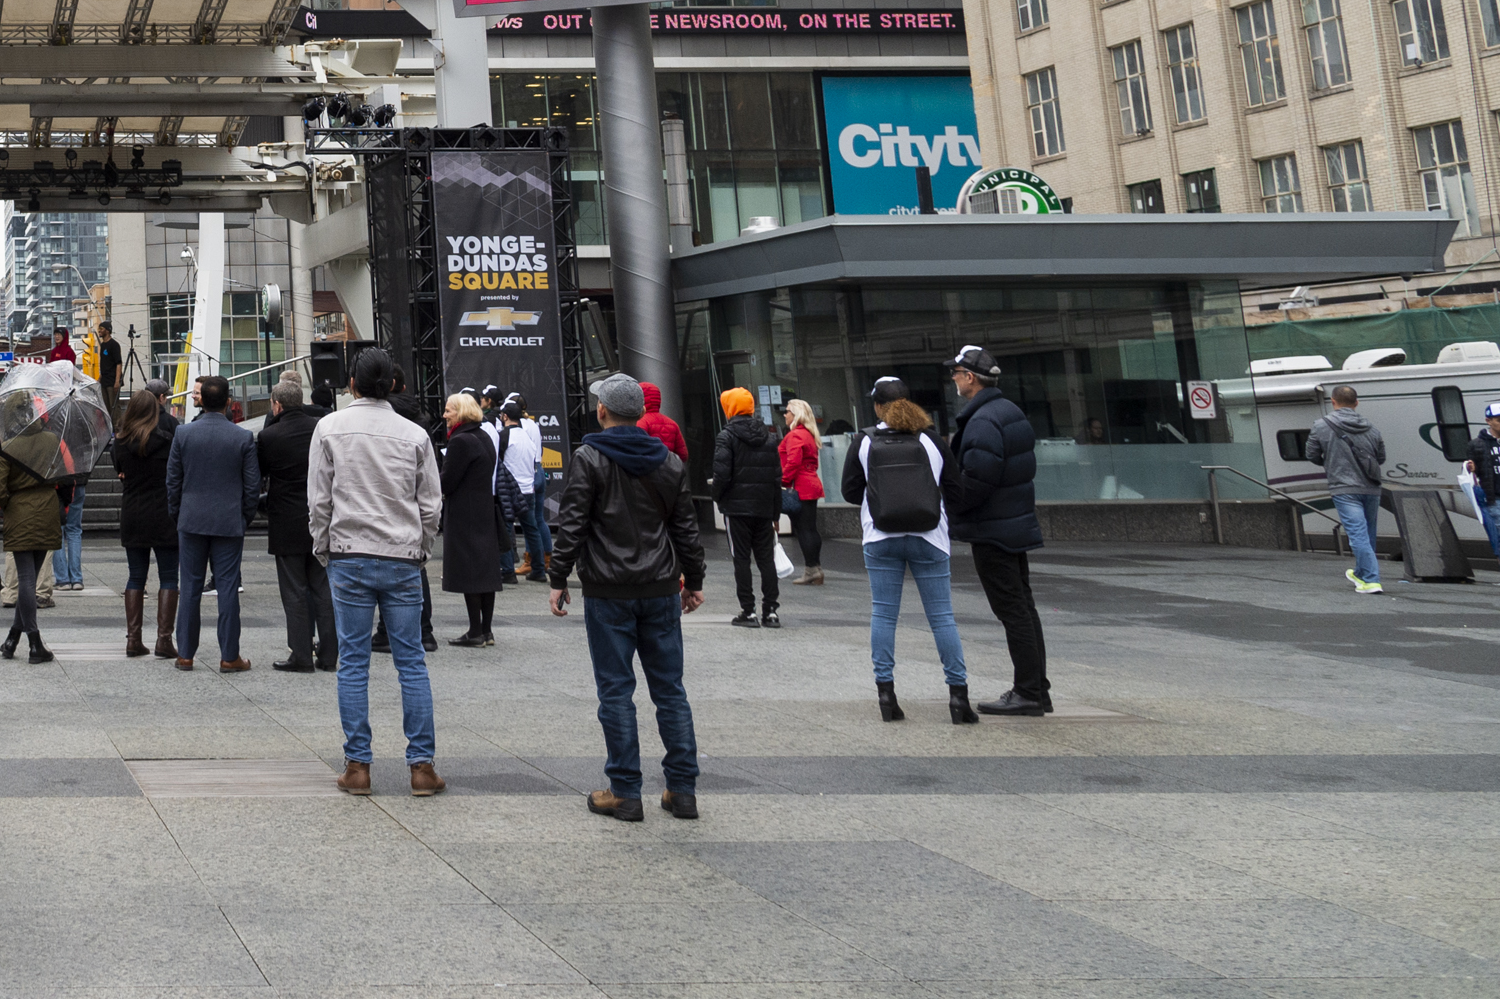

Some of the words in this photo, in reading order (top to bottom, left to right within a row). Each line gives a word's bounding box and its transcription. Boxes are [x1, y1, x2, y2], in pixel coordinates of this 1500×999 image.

[544, 14, 583, 29] OUT
[666, 14, 788, 31] NEWSROOM,
[799, 14, 828, 29] ON
[832, 14, 871, 29] THE
[880, 13, 956, 29] STREET.
[446, 236, 545, 254] YONGE-
[448, 254, 548, 272] DUNDAS
[449, 272, 549, 290] SQUARE
[459, 337, 544, 347] CHEVROLET
[1386, 463, 1437, 478] Santara
